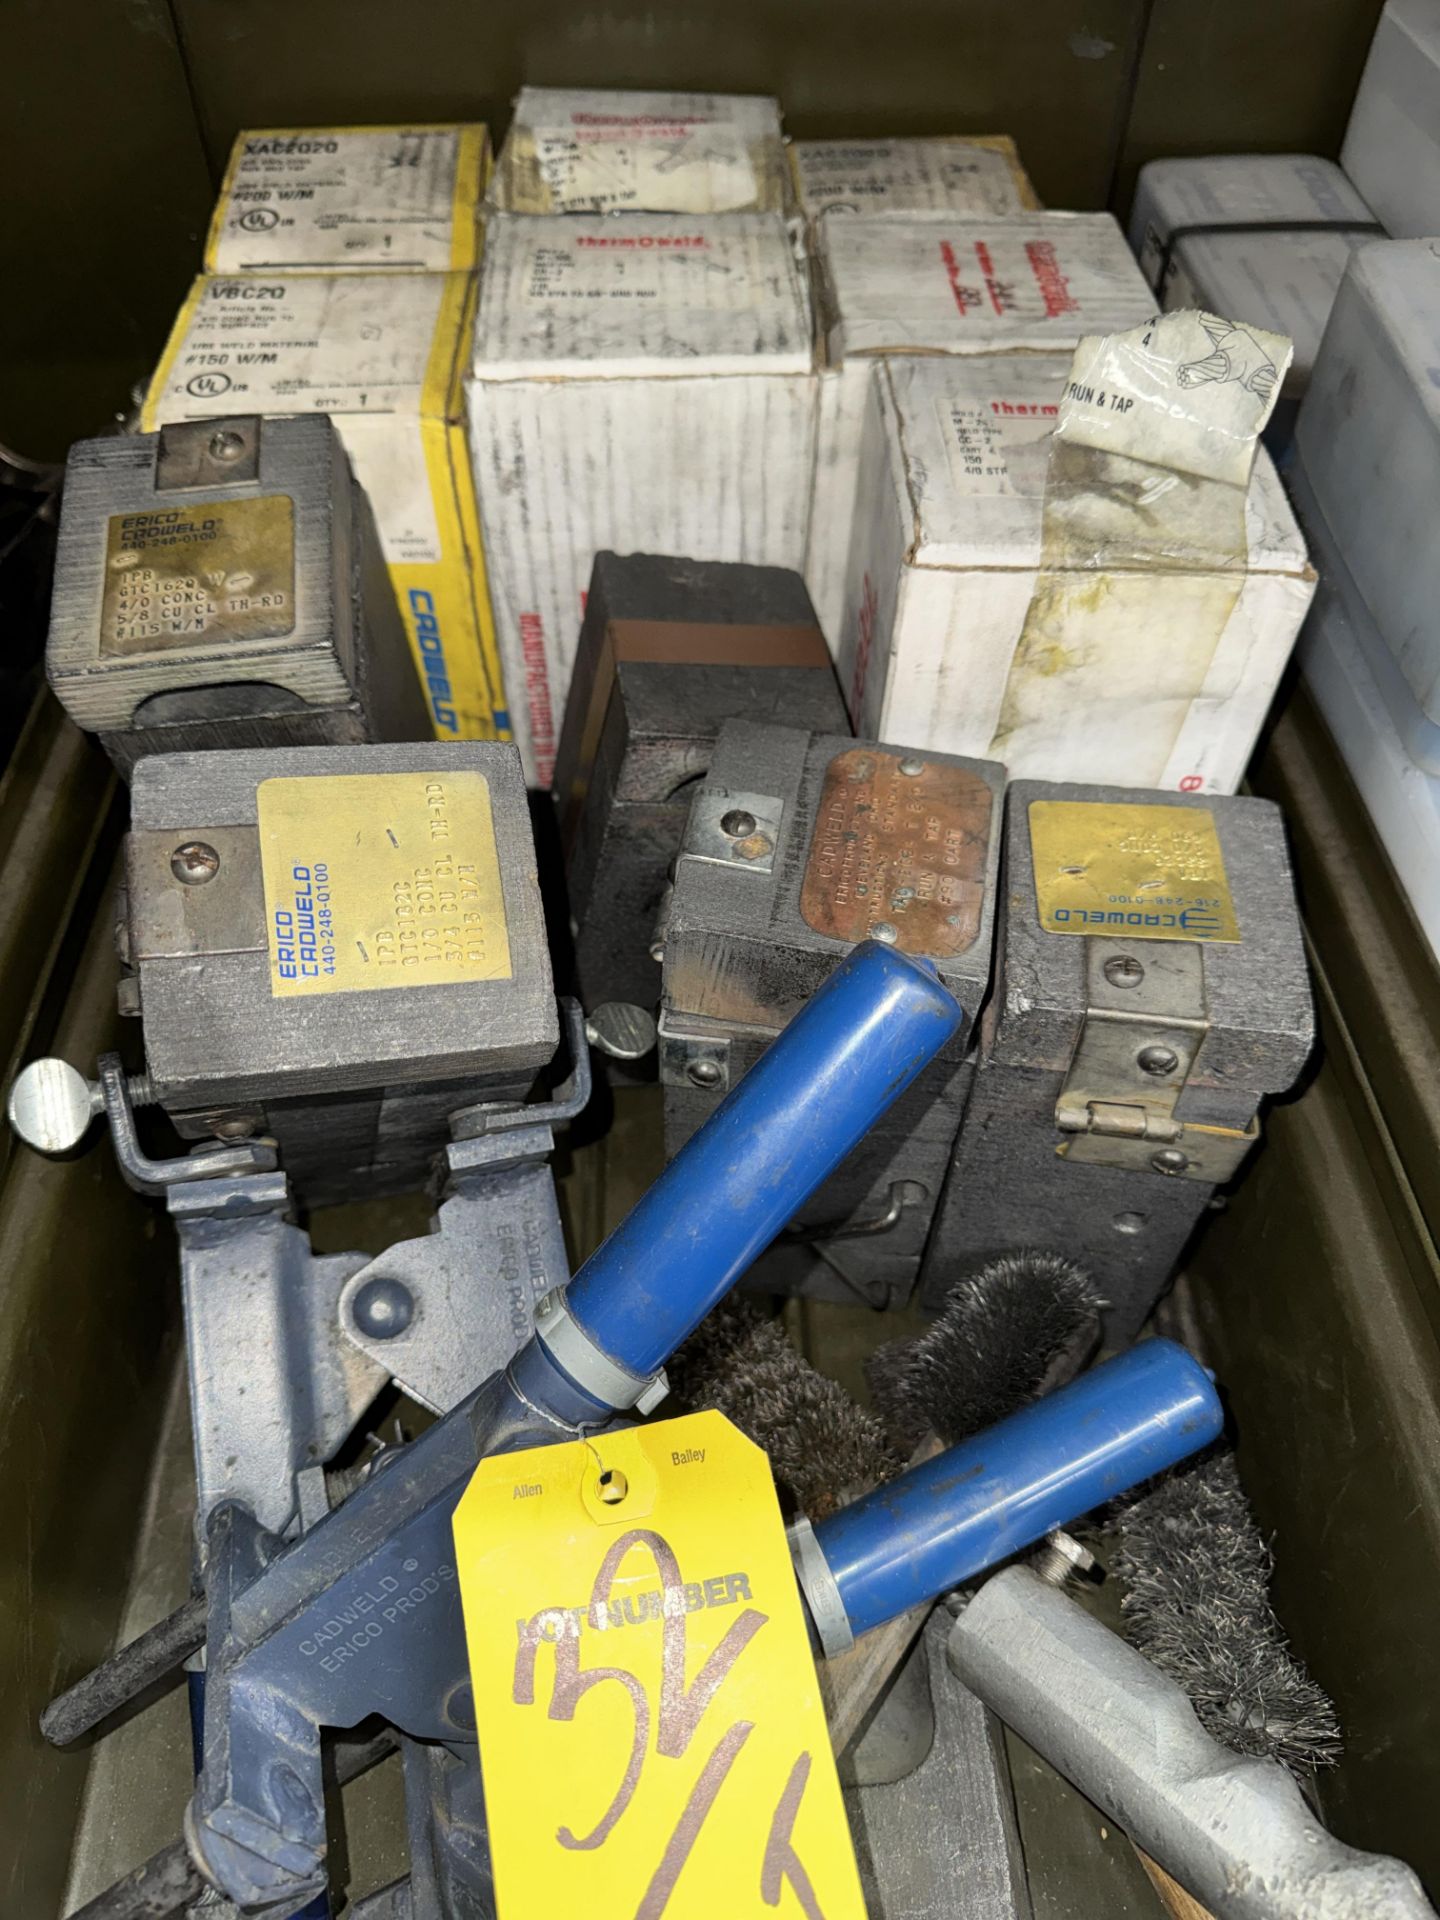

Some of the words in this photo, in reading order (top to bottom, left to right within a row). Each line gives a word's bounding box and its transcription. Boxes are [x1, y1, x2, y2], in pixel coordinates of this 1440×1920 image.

[1141, 332, 1152, 348] 4
[186, 354, 229, 365] #150
[237, 352, 278, 365] W/M
[991, 401, 1058, 416] therm
[1068, 382, 1095, 403] RUN
[1096, 391, 1106, 407] &
[1110, 395, 1134, 413] TAP
[964, 455, 983, 465] 150
[121, 512, 180, 530] ERICO
[121, 519, 216, 542] CADWELD
[117, 610, 150, 625] 5/8
[161, 607, 182, 619] CU
[194, 603, 217, 616] CL
[229, 594, 285, 612] TH-RD
[119, 597, 151, 611] 4/0
[161, 592, 206, 606] CONC
[115, 622, 160, 639] #115
[172, 618, 205, 632] W/M
[408, 588, 460, 734] CADWELD
[426, 783, 449, 841] TH-RD
[816, 802, 847, 879] CADWELD
[924, 817, 942, 843] TAP
[943, 829, 962, 866] CART
[435, 854, 453, 878] CL
[415, 867, 436, 916] CONC
[439, 890, 459, 914] CU
[917, 872, 937, 903] RUN
[293, 866, 319, 977] CADWELD
[314, 863, 336, 975] 440-248-0100
[1055, 908, 1177, 927] CADWELD
[275, 911, 297, 979] ERICO
[422, 927, 442, 962] 1/0
[443, 926, 464, 962] 3/4
[463, 912, 486, 962] #115
[521, 1219, 549, 1298] CADWEL
[671, 1448, 707, 1467] Bailey
[512, 1482, 543, 1500] Allen
[299, 1575, 400, 1656] CADWELD
[595, 1571, 754, 1631] NUMBER
[319, 1621, 384, 1674] ERICO
[381, 1565, 456, 1624] PROD'S
